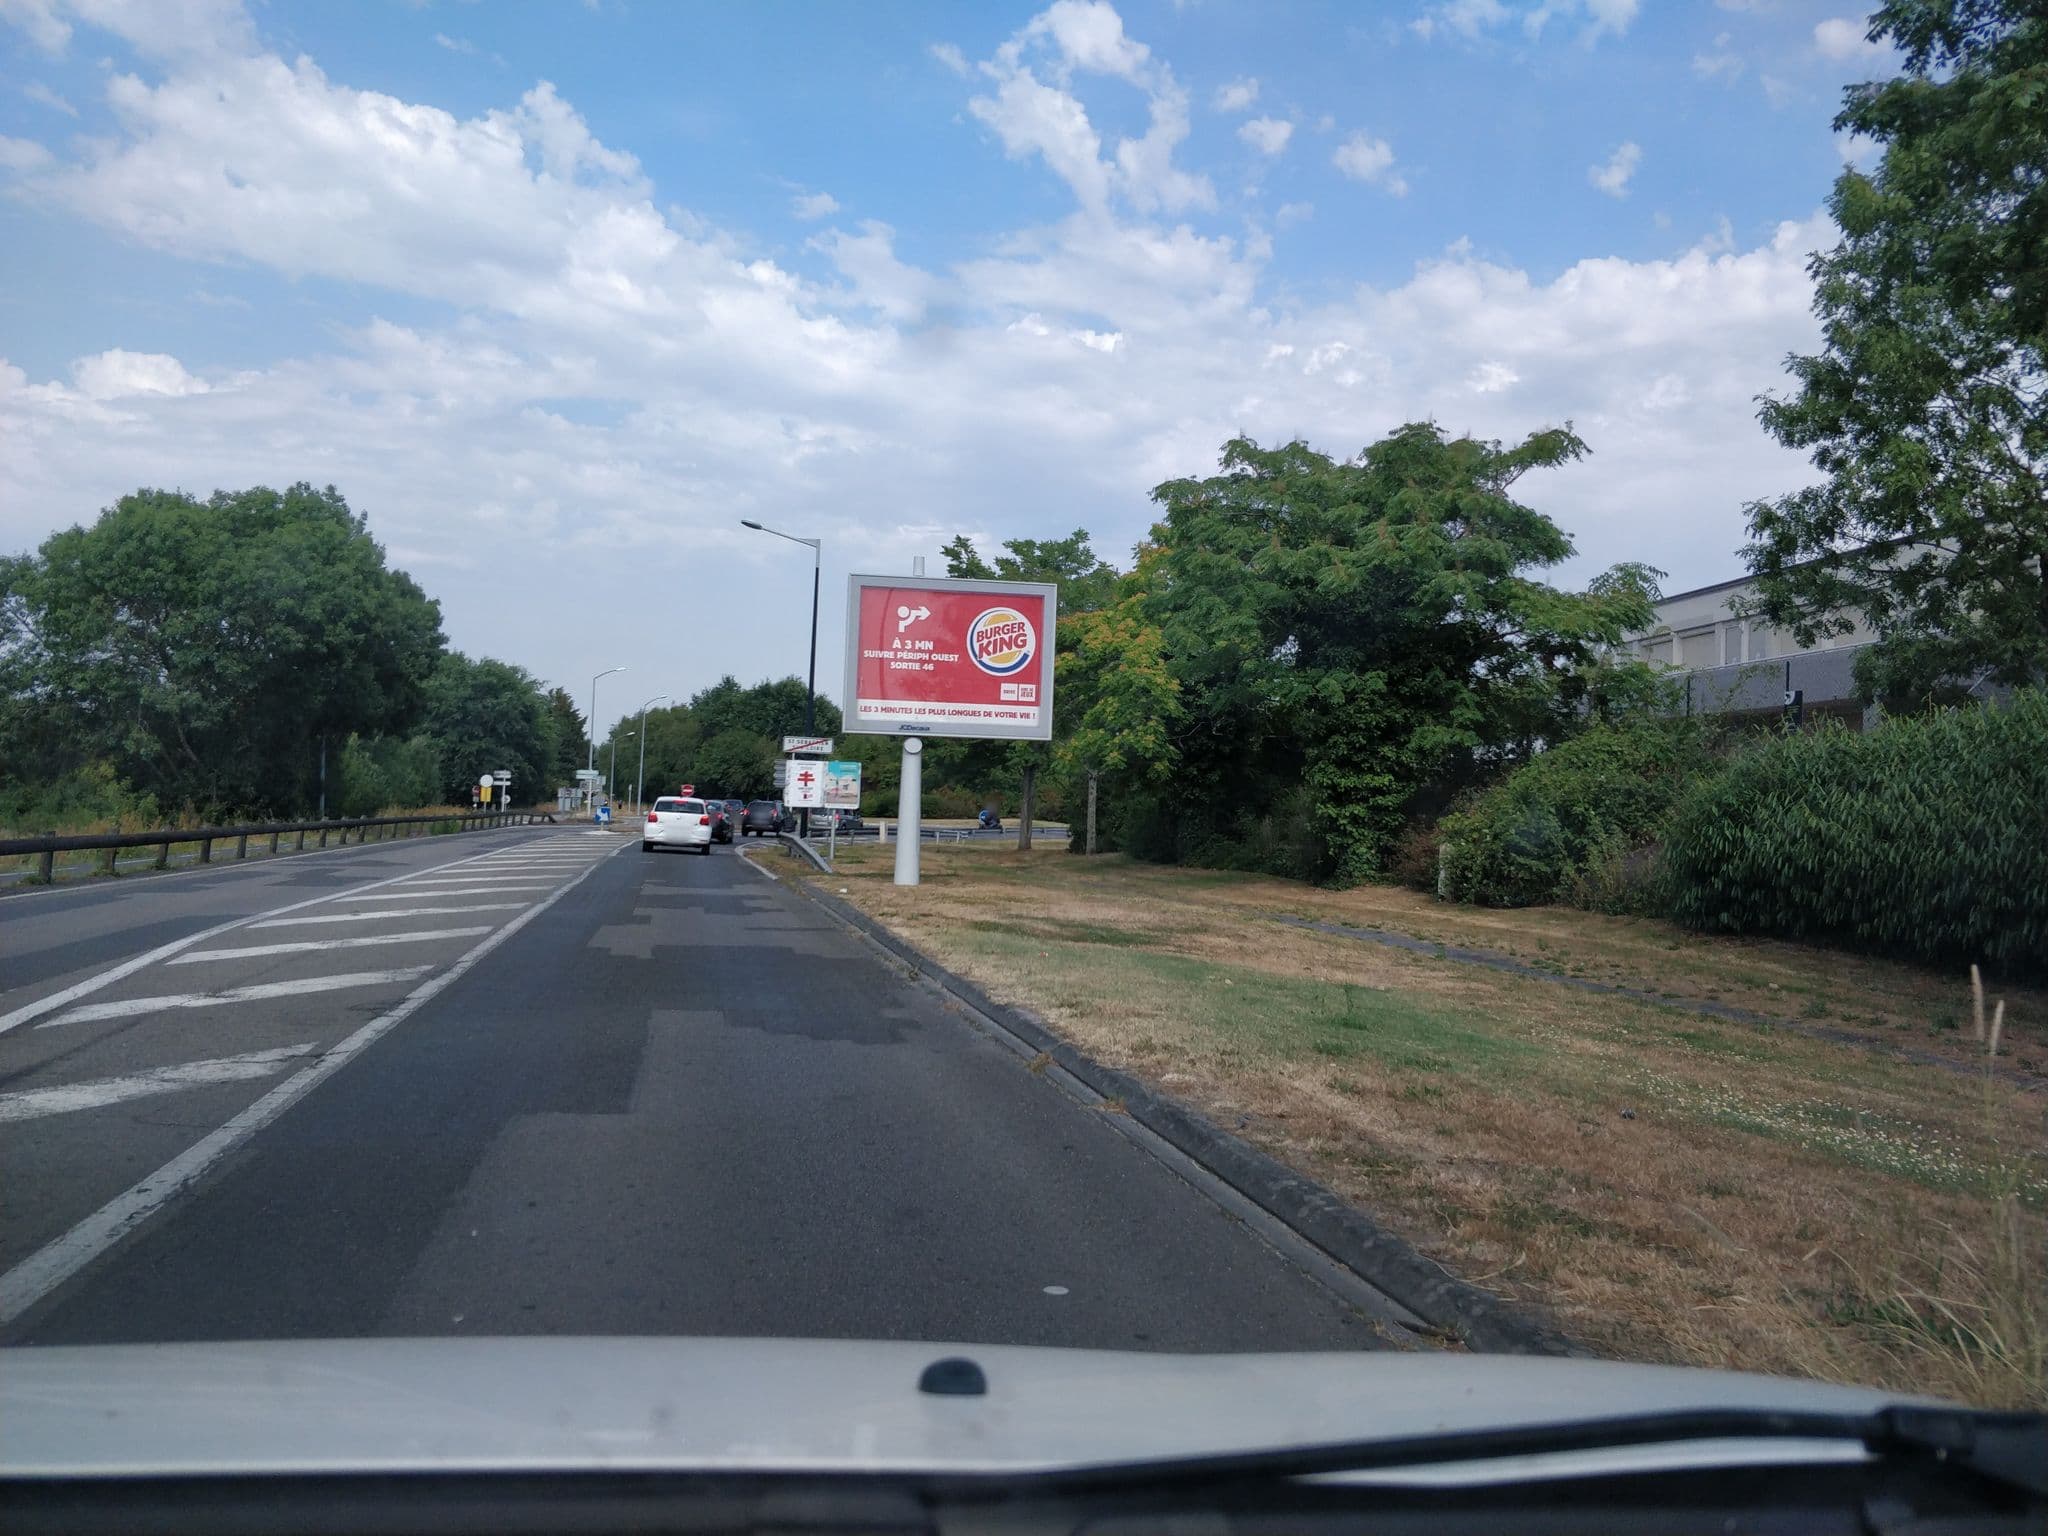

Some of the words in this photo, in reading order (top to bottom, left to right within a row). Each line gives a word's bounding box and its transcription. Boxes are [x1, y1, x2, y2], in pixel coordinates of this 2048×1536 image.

[977, 622, 1025, 643] BURGER
[892, 637, 901, 649] À
[905, 640, 912, 649] 3
[915, 641, 933, 650] MN
[978, 633, 1027, 659] KING
[864, 650, 895, 658] SUIVRE
[897, 650, 929, 660] PÉRIPH
[931, 653, 959, 662] OUEST
[890, 661, 921, 670] SORTIE
[922, 663, 934, 671] 46
[880, 706, 912, 714] MINUTES
[914, 707, 926, 715] LES
[948, 709, 981, 717] LONGUES
